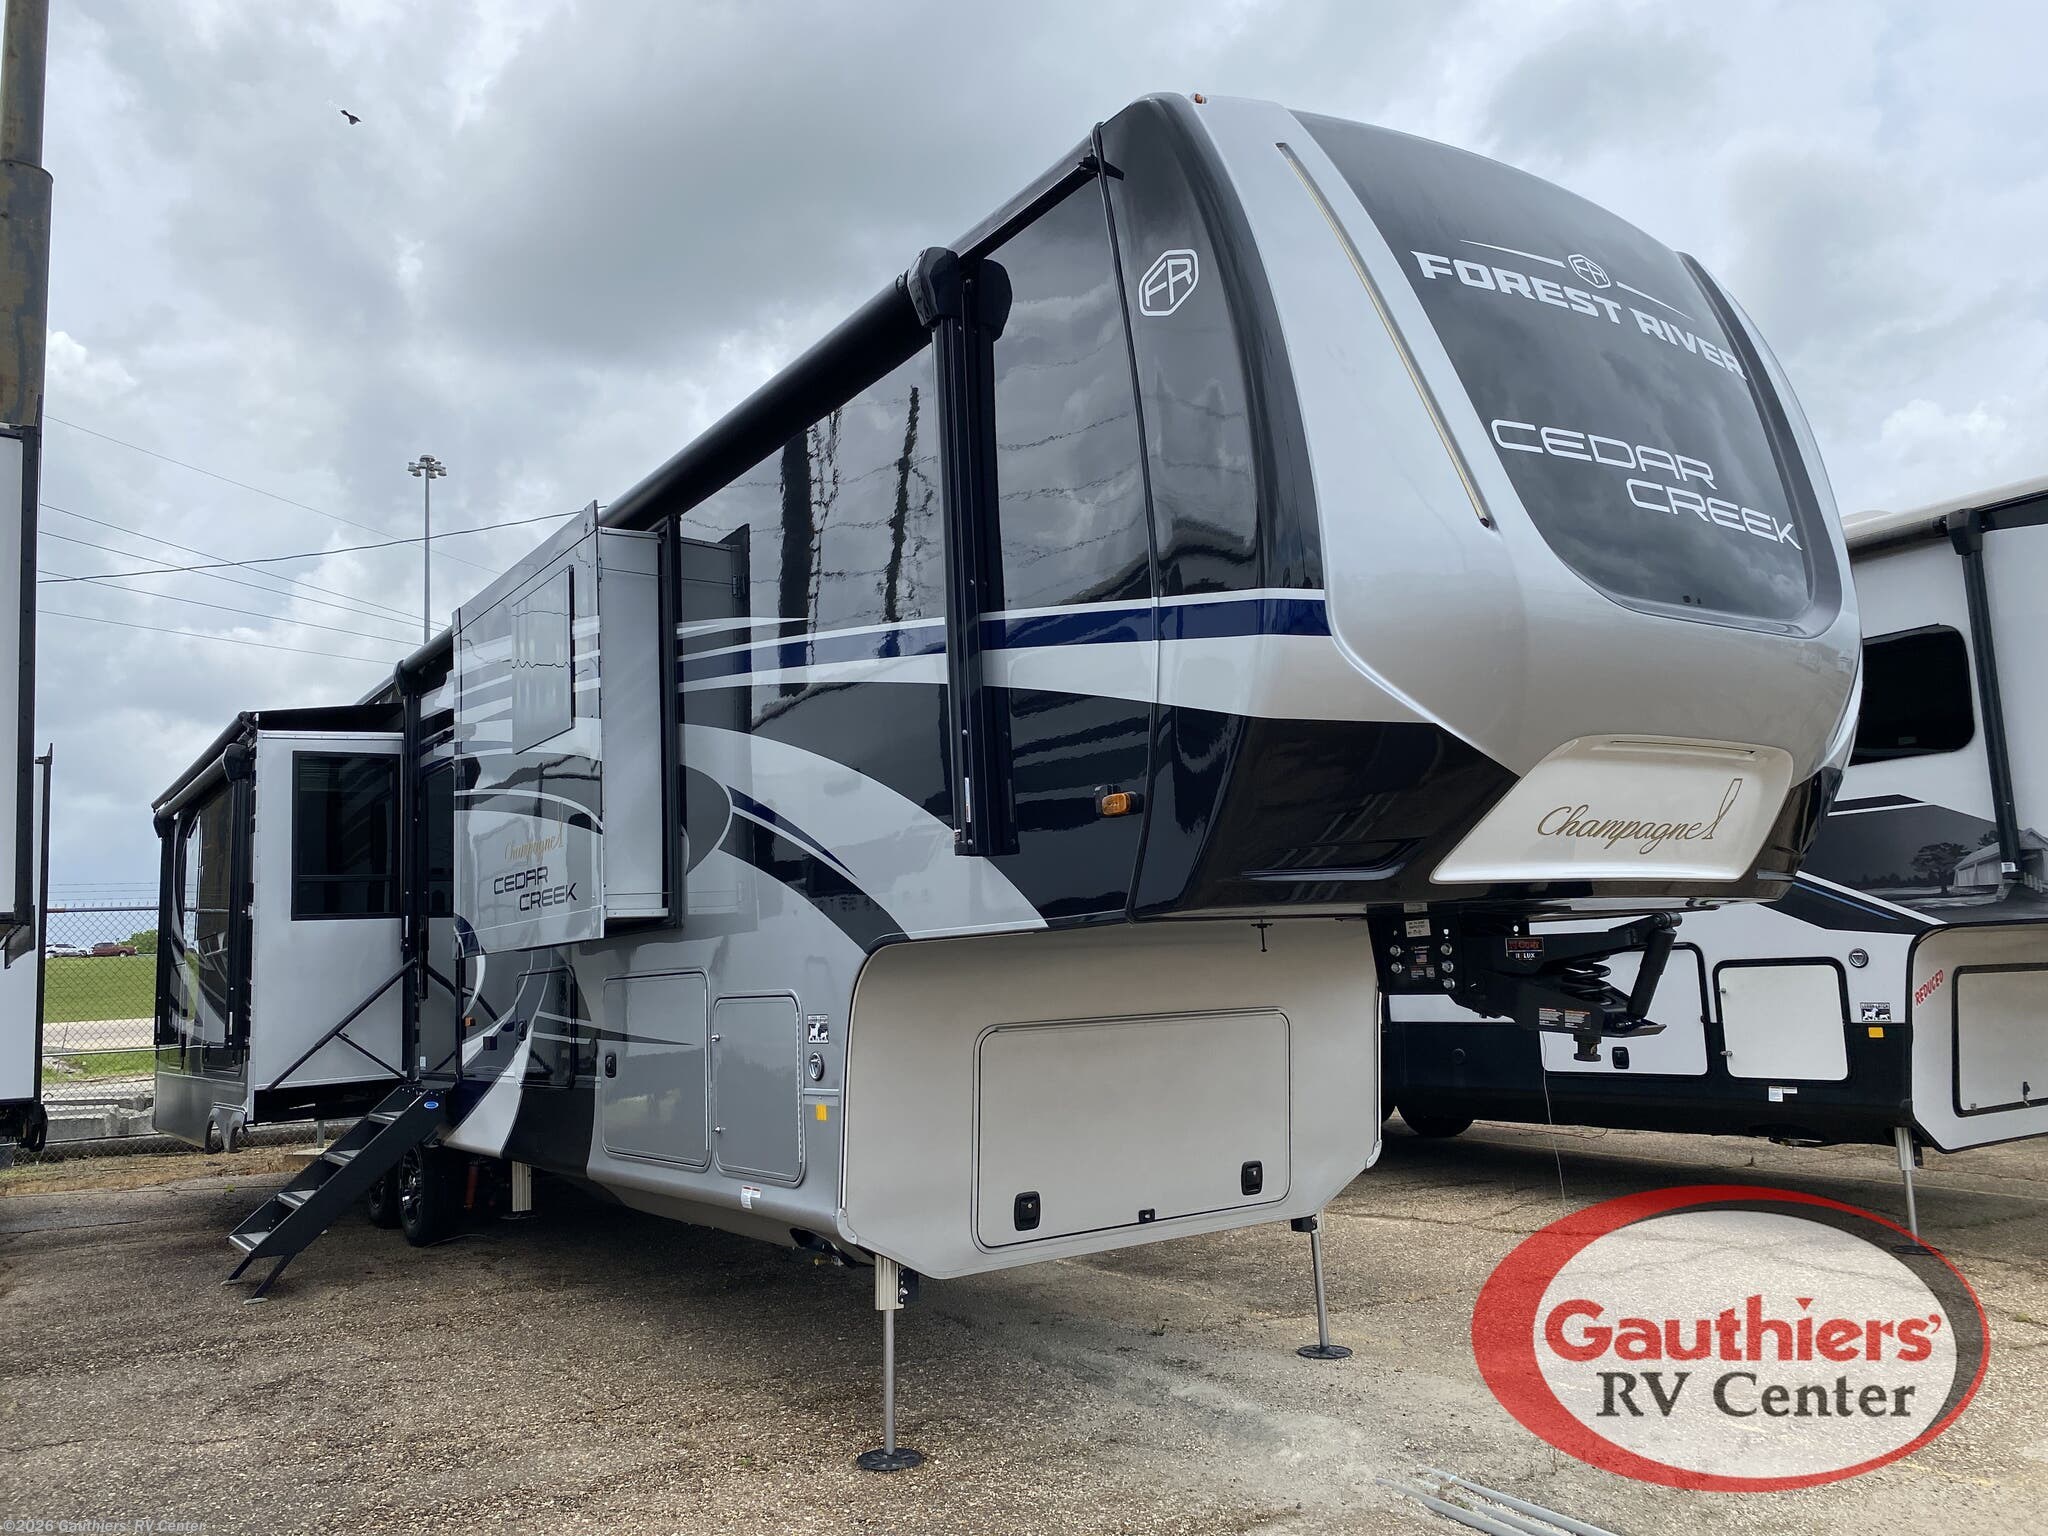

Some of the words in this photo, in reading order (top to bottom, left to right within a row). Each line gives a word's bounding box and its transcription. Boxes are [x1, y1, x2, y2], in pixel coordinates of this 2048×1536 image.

[1410, 250, 1621, 324] FOREST
[1630, 307, 1747, 380] RIVER
[1491, 419, 1716, 490] CEDAR
[1626, 478, 1802, 550] CREEK
[1537, 804, 1703, 855] Champagne
[494, 866, 549, 895] CEDAR
[520, 883, 577, 912] CREEK
[1915, 969, 1944, 1006] REDUCED
